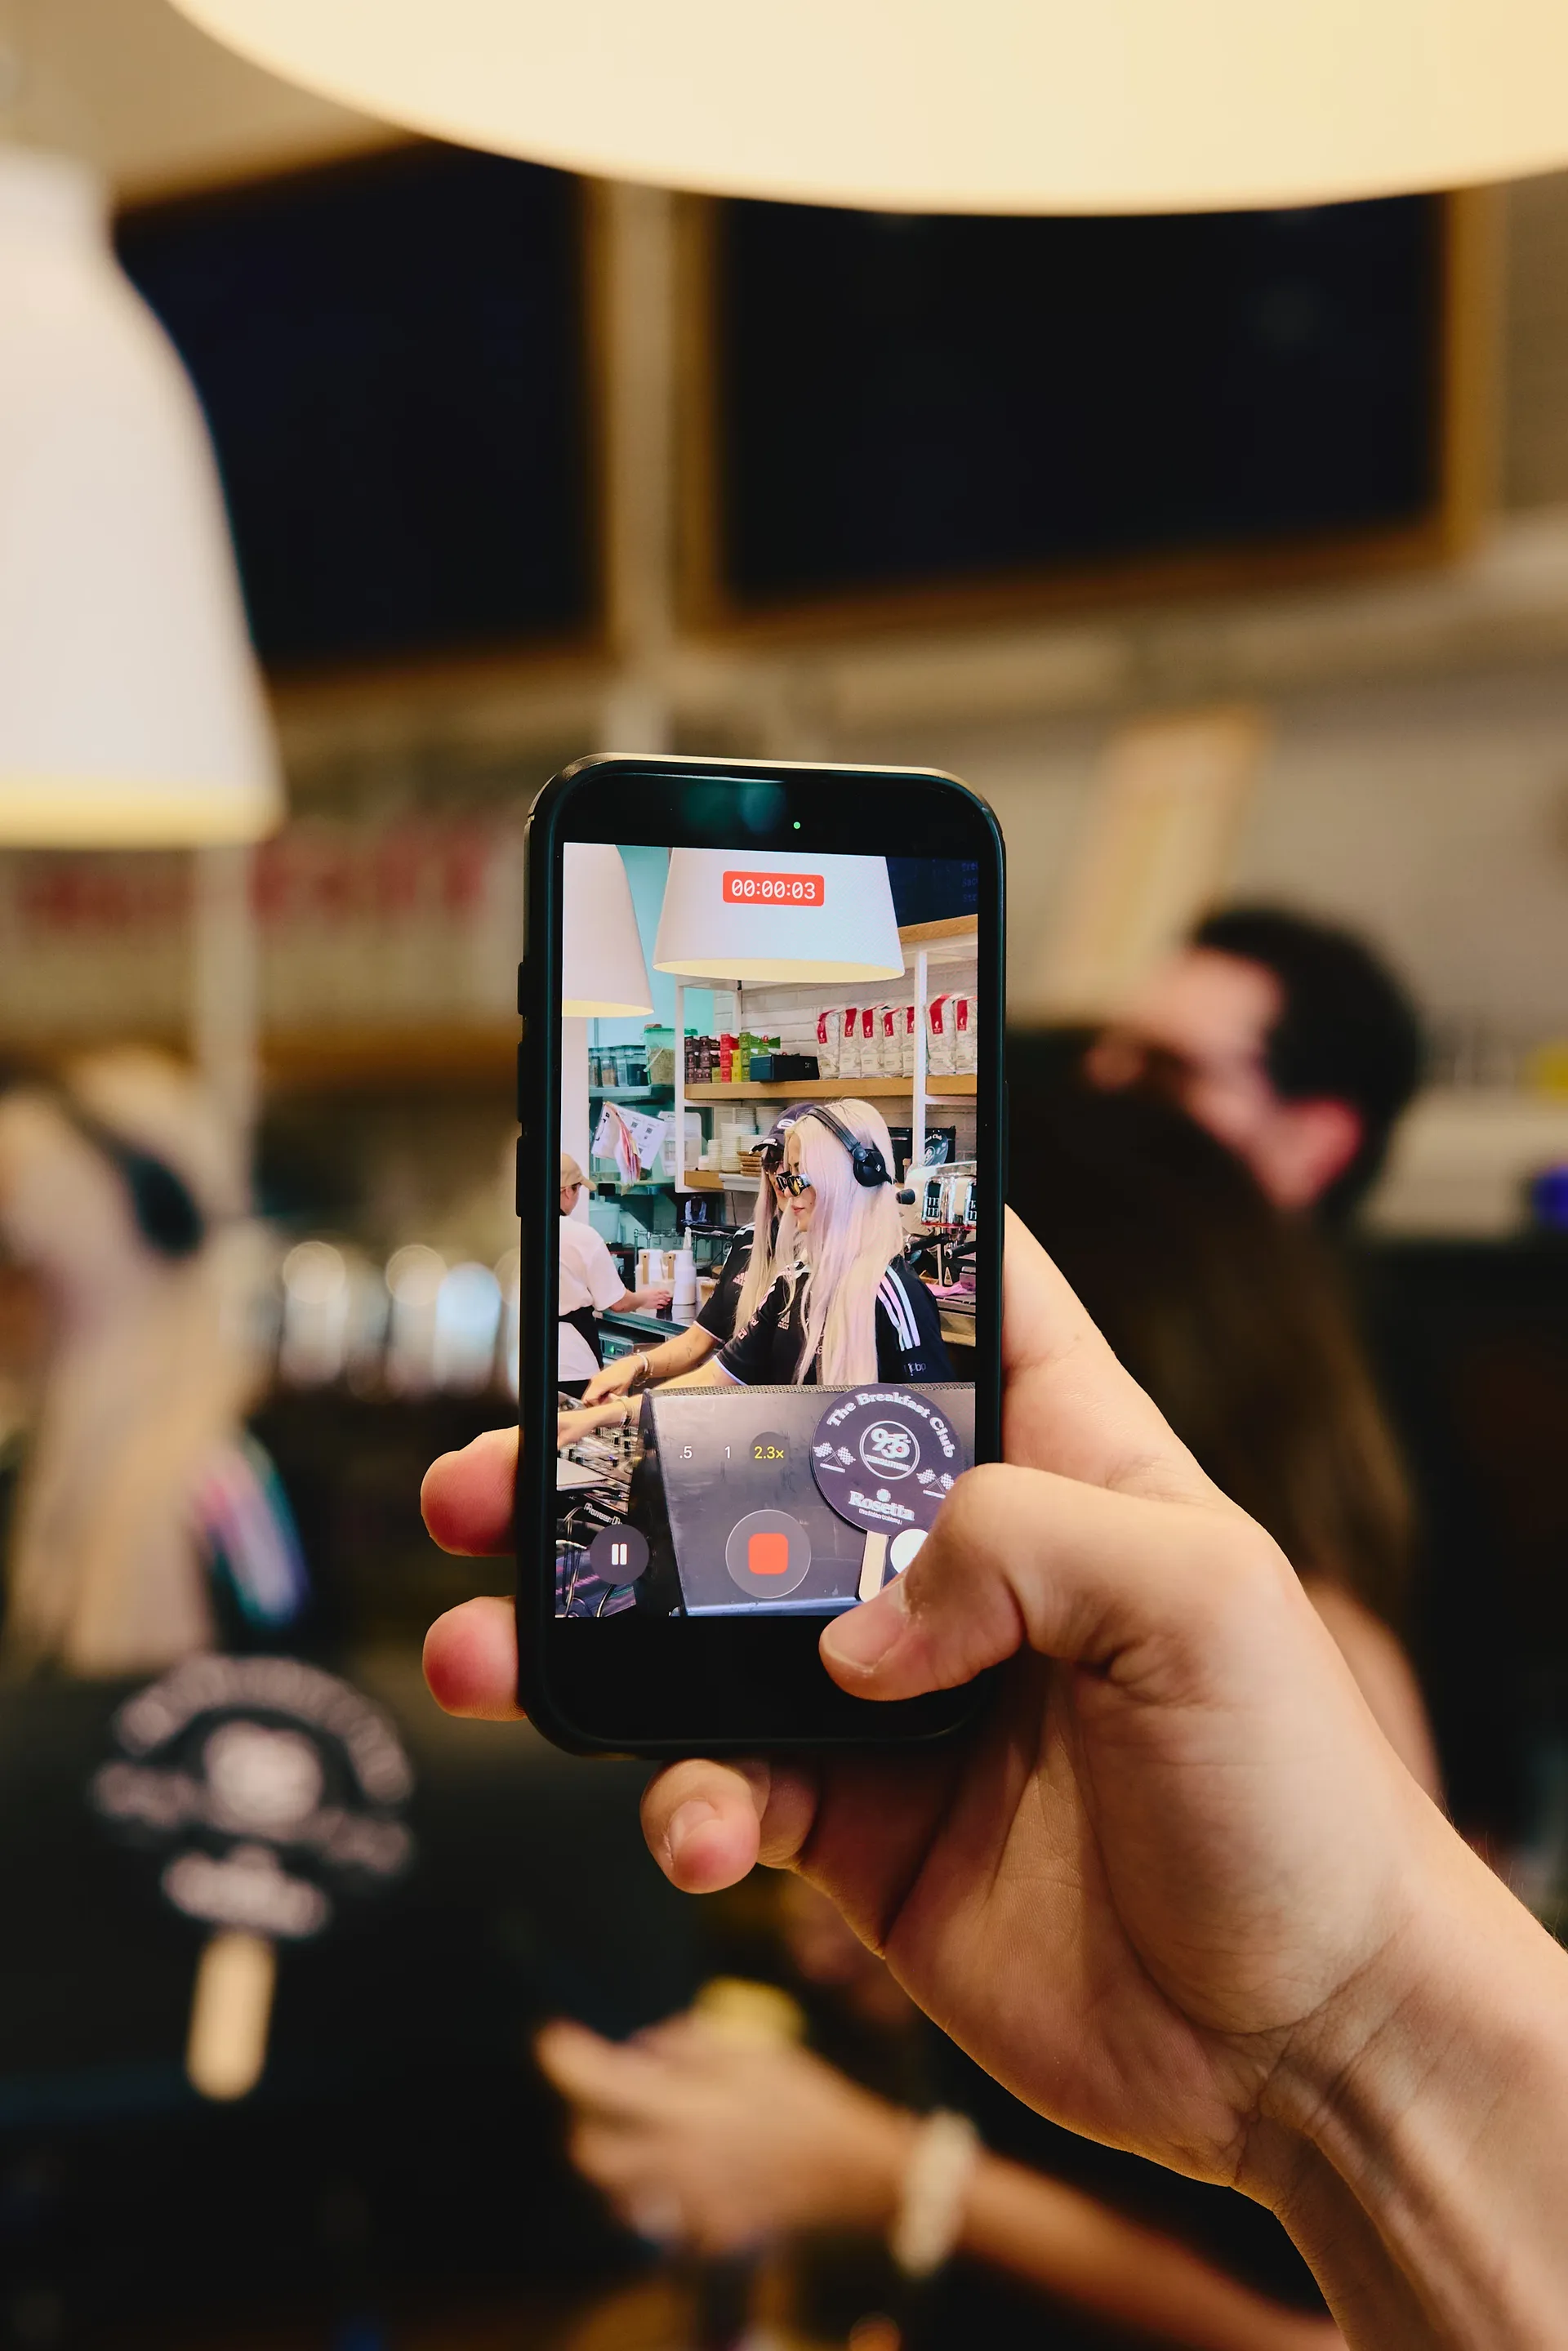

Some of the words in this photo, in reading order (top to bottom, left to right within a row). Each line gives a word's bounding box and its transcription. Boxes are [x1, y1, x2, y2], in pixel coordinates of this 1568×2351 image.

[732, 879, 816, 900] 00:00:03
[826, 1402, 856, 1427] The
[855, 1392, 931, 1418] Breakfast
[929, 1417, 956, 1458] Club
[679, 1445, 693, 1459] .5
[724, 1445, 731, 1459] 1
[754, 1445, 784, 1459] 2.3x
[849, 1490, 915, 1521] Rosetta
